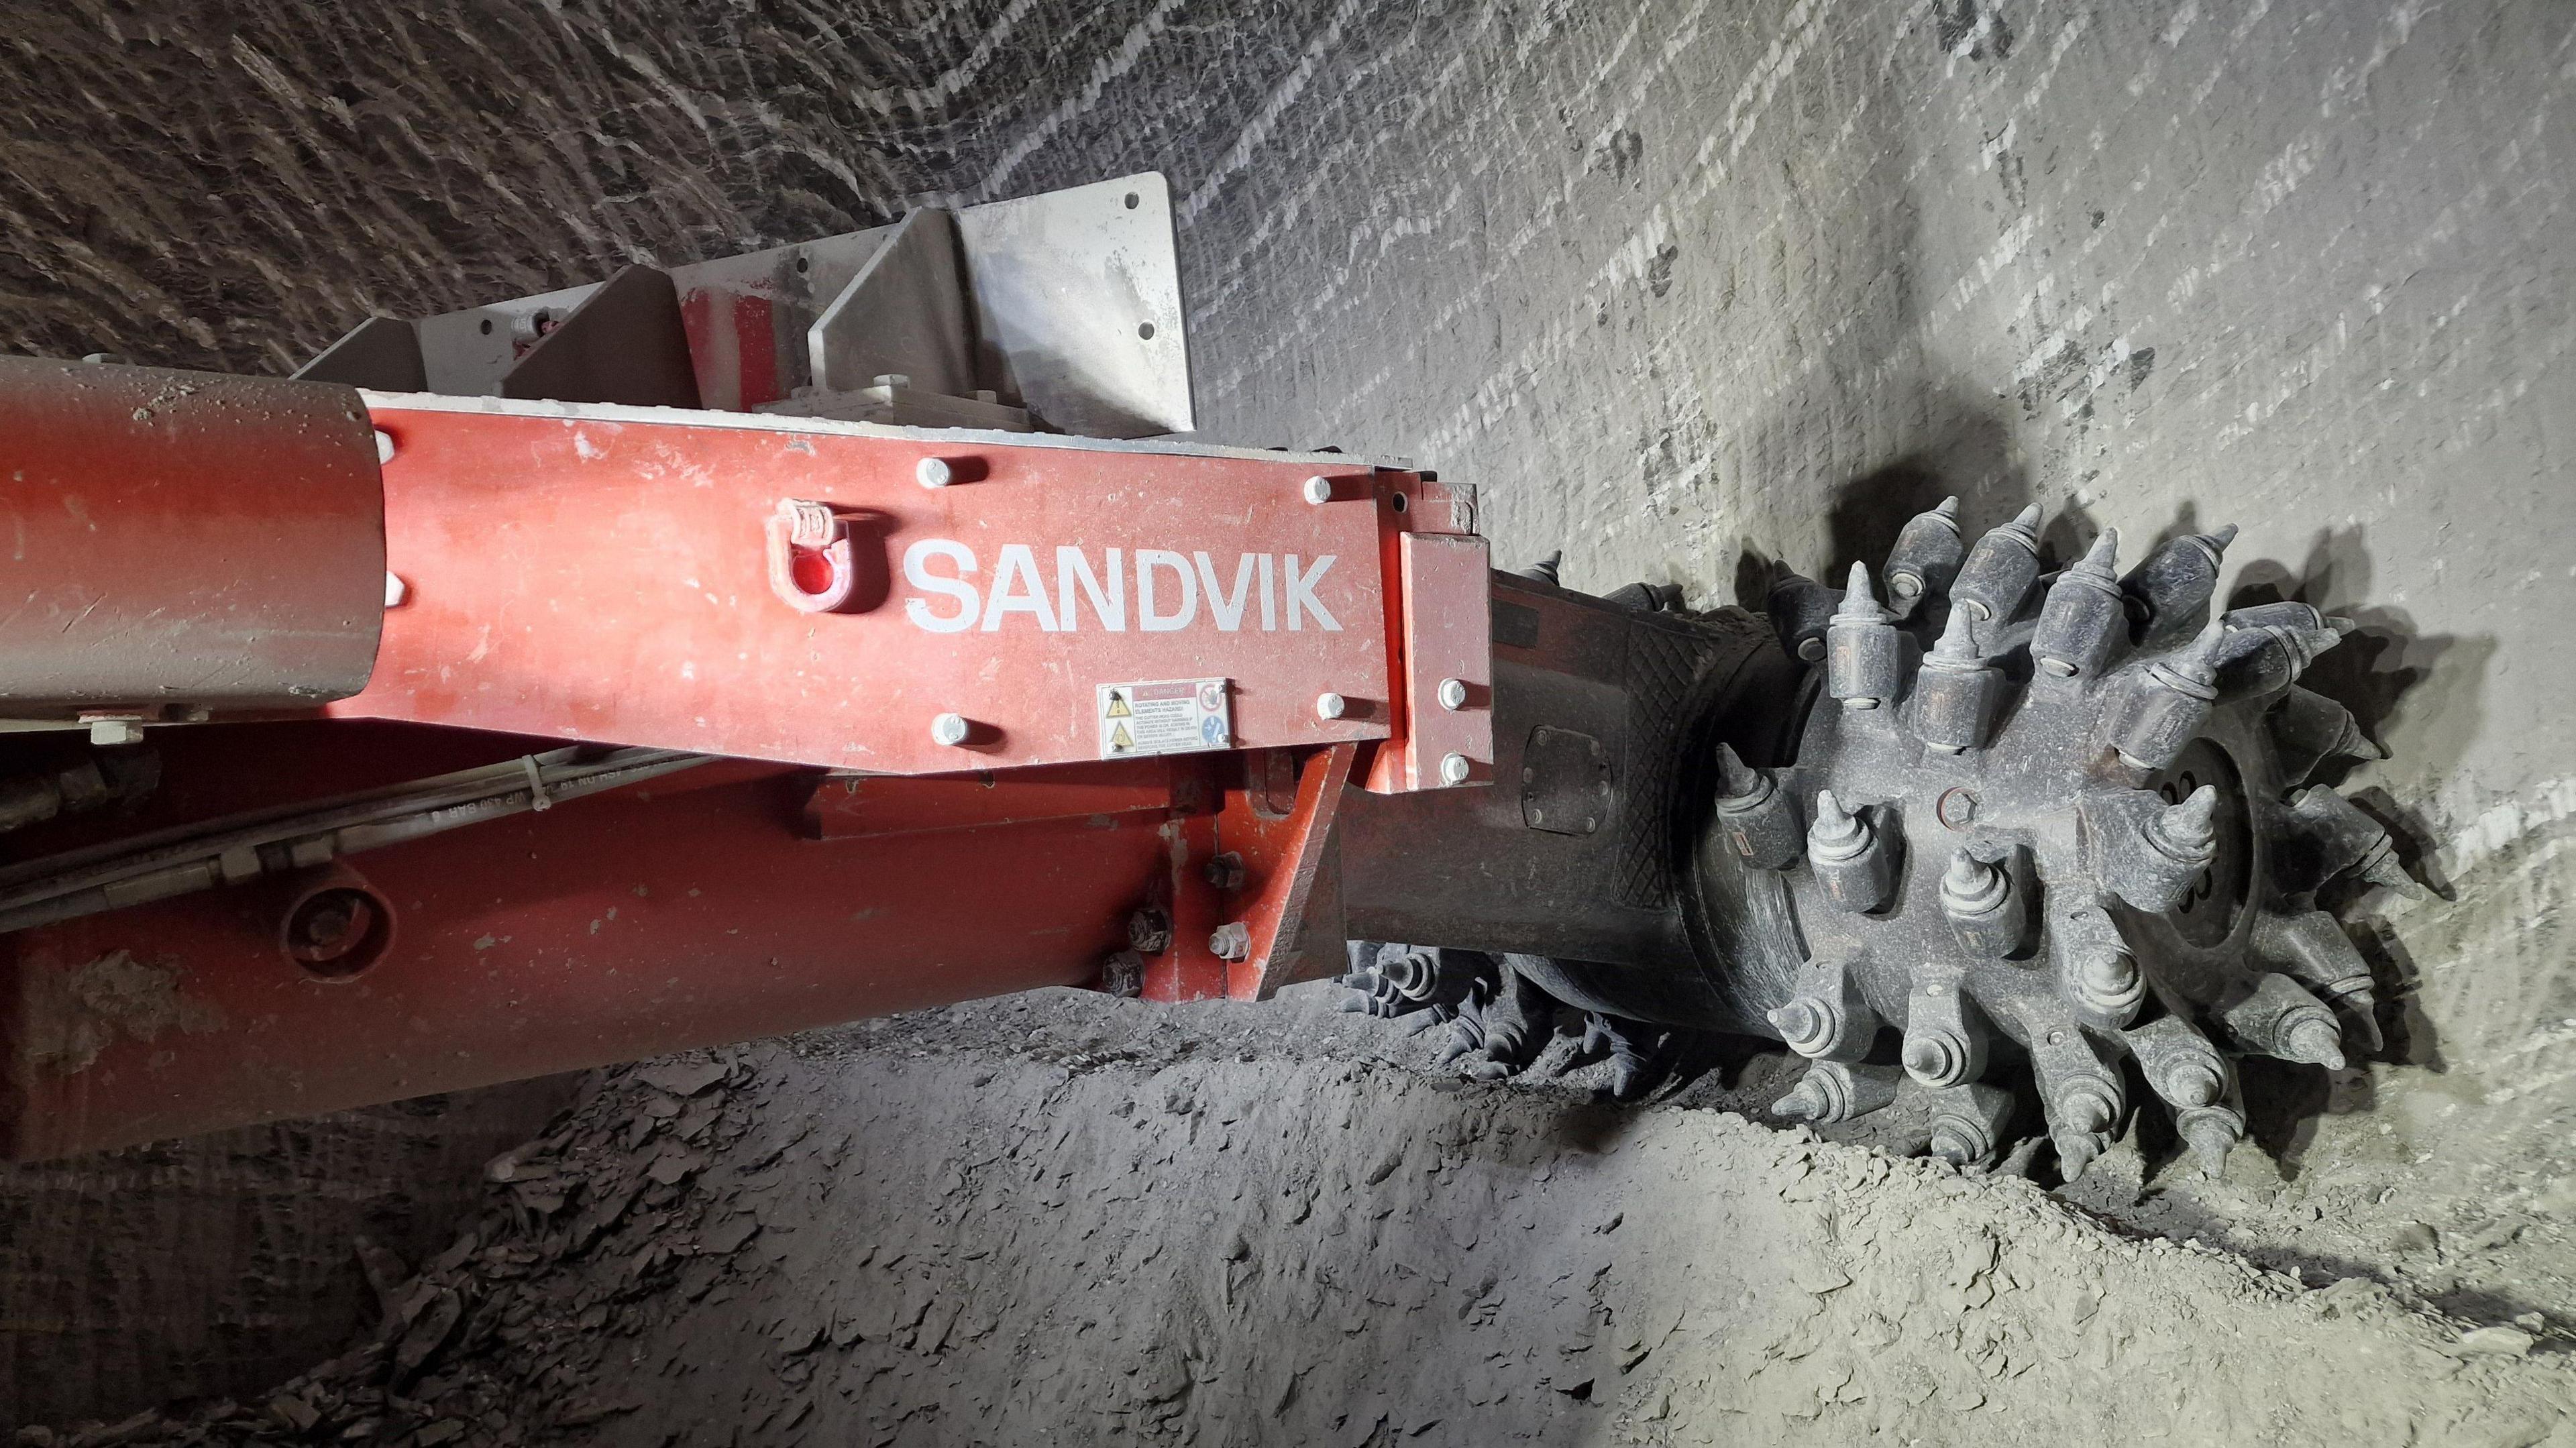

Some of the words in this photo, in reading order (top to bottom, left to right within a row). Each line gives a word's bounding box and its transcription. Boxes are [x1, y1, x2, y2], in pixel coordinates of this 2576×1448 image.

[903, 538, 1343, 632] SANDVIK
[1154, 687, 1184, 695] DANGER
[480, 798, 502, 811] 430
[506, 791, 525, 805] WP
[448, 803, 476, 818] BAR
